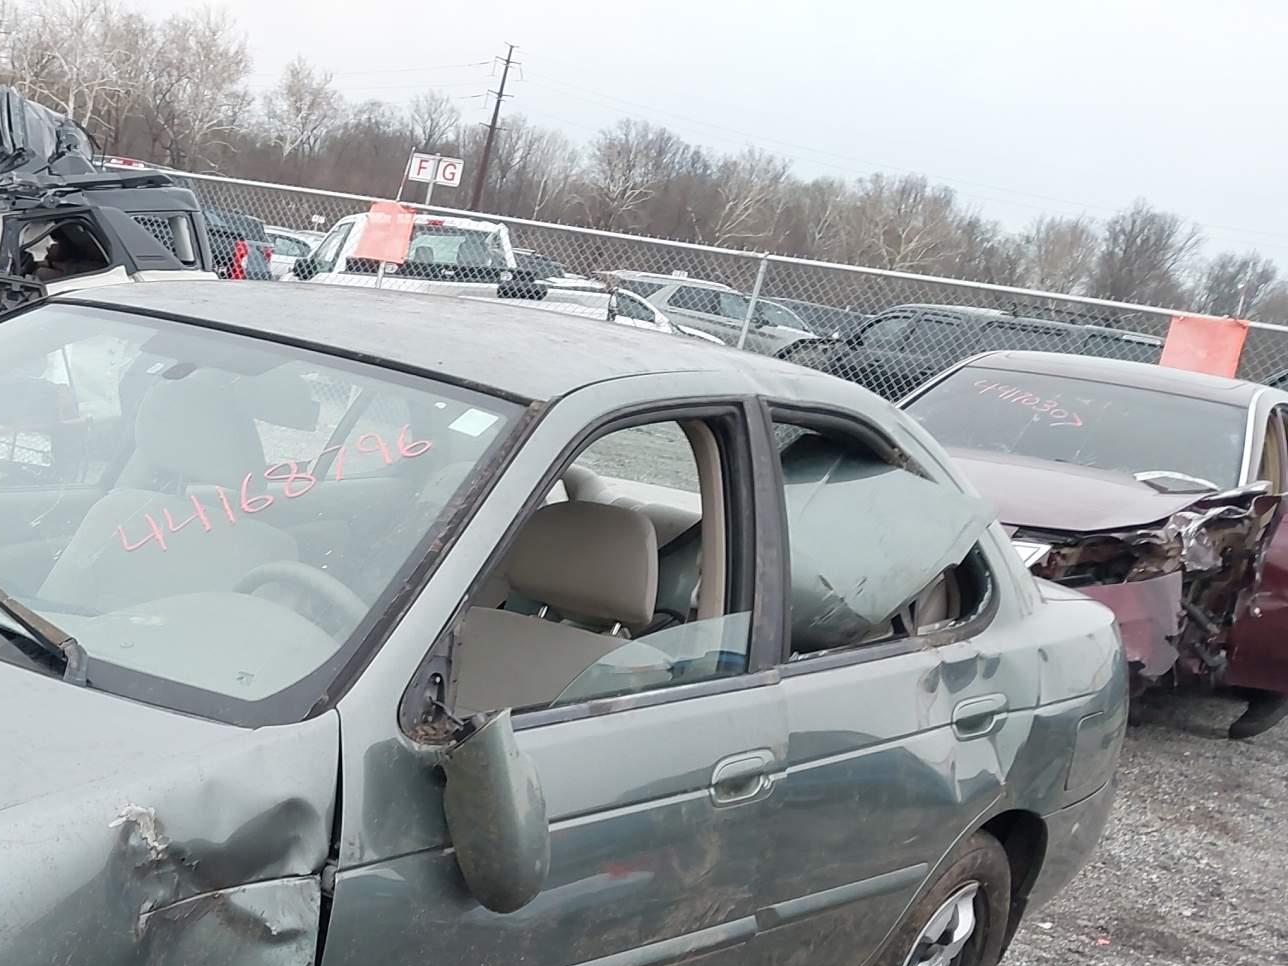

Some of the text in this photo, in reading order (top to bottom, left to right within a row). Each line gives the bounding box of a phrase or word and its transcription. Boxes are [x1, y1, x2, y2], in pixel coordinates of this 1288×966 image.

[416, 158, 430, 177] F
[442, 163, 457, 182] G
[113, 425, 432, 553] 44168796
